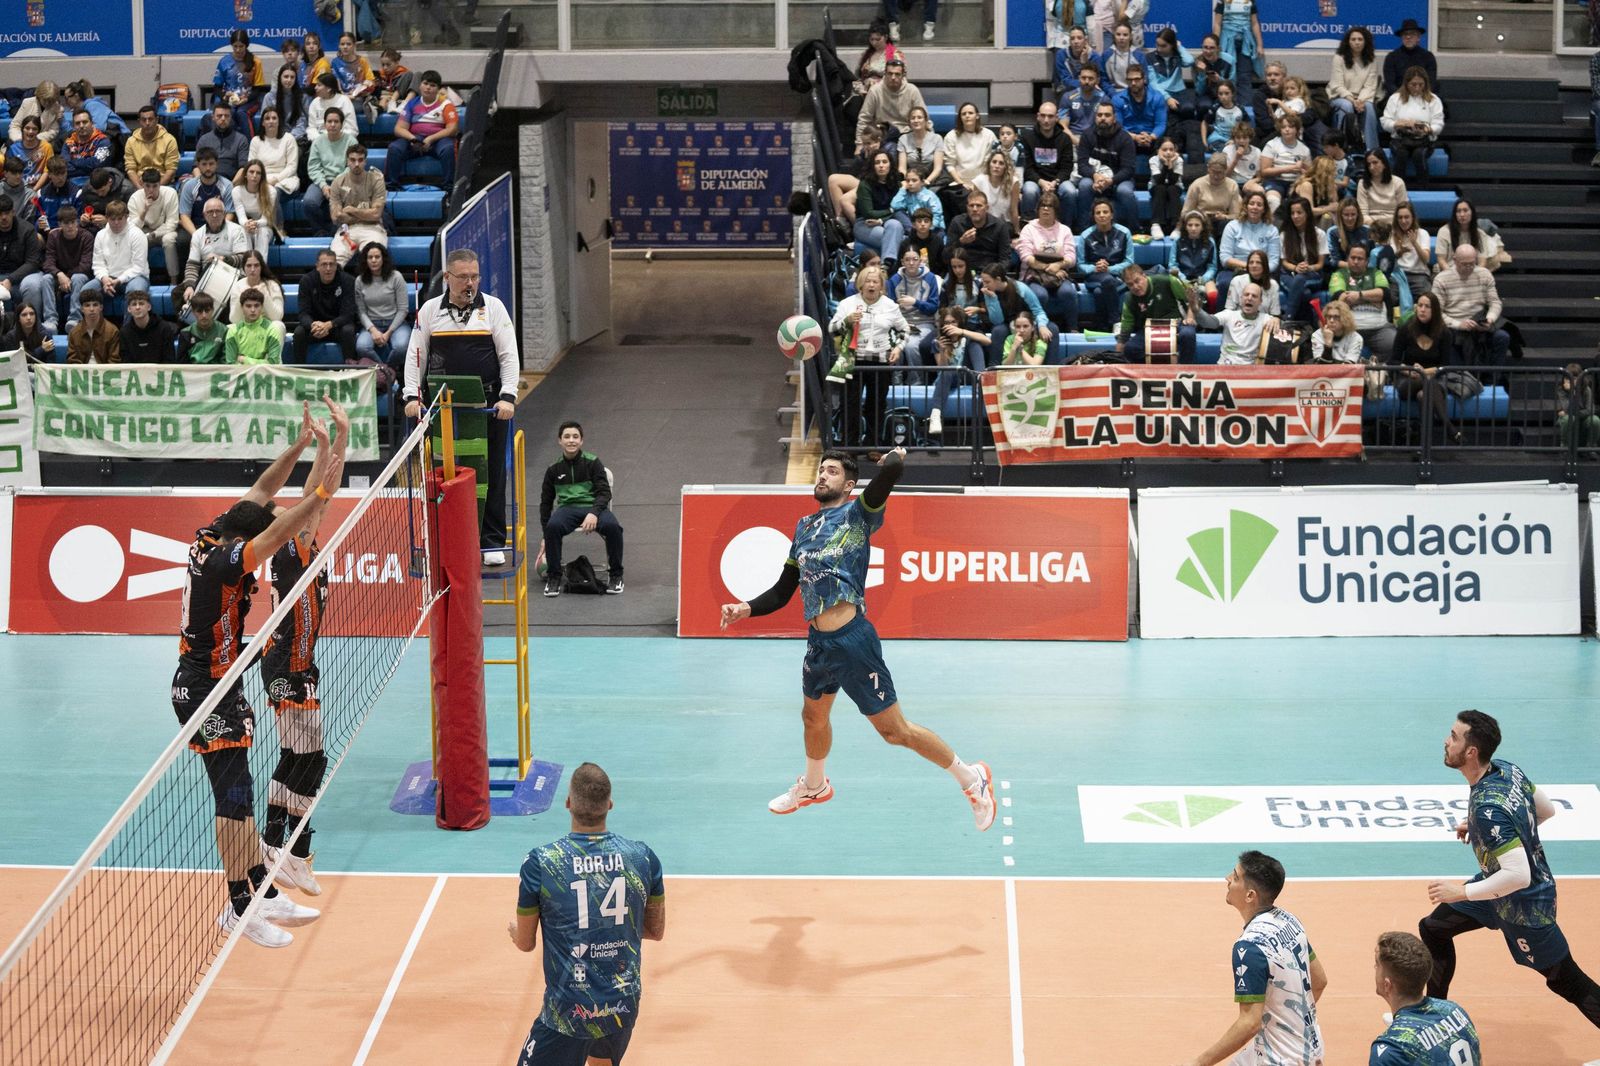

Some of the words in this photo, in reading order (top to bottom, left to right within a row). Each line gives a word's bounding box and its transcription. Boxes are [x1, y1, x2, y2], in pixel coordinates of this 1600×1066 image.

[39, 33, 53, 42] DE
[55, 30, 100, 42] ALMERÍA
[247, 29, 261, 37] DE
[1260, 22, 1326, 33] DIPUTACIÓN
[1330, 24, 1344, 33] DE
[660, 95, 715, 110] SALIDA
[700, 168, 768, 180] DIPUTACIÓN
[701, 180, 716, 190] DE
[718, 178, 766, 190] ALMERÍA
[210, 373, 359, 402] CAMPEON
[1111, 374, 1235, 409] PEÑA
[191, 416, 232, 443] LA
[1064, 416, 1111, 446] LA
[1135, 415, 1286, 446] UNION
[1298, 512, 1552, 556] Fundación
[901, 551, 1091, 582] SUPERLIGA
[1299, 560, 1480, 615] Unicaja
[869, 672, 879, 690] 7
[1265, 796, 1574, 812] Fundacn
[1271, 811, 1468, 832] Unicaj
[573, 854, 625, 874] BORJA
[570, 877, 629, 929] 14
[591, 940, 629, 951] Fundación
[591, 948, 618, 960] Unicaja
[1517, 938, 1531, 953] 6
